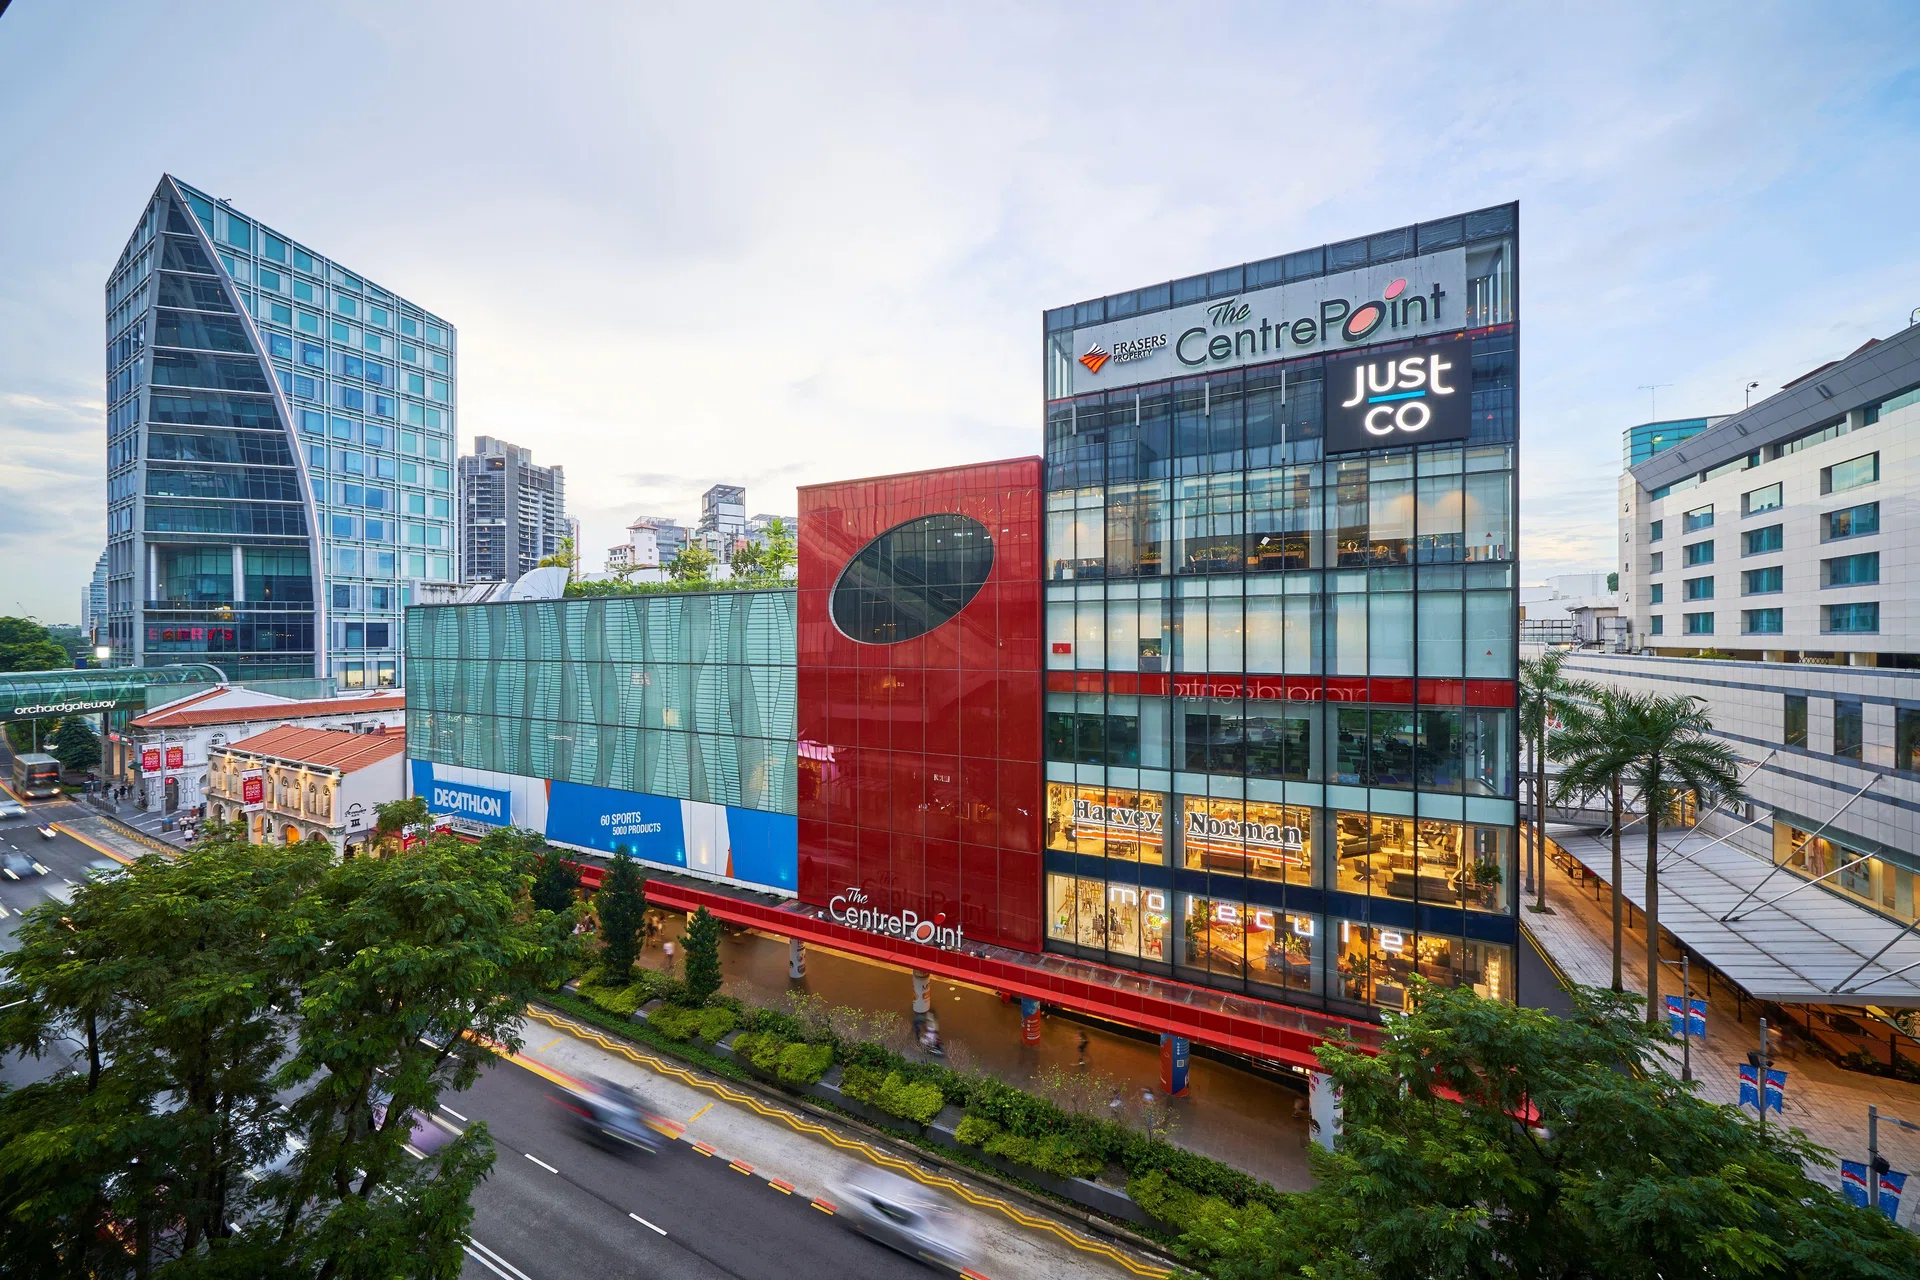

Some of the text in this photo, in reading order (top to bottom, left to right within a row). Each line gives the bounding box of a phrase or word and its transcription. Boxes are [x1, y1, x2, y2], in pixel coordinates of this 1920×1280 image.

[1175, 278, 1446, 366] CentrePoint
[1207, 298, 1250, 327] The
[1113, 334, 1167, 354] FRASERS
[1113, 348, 1153, 363] PROPERTY
[14, 700, 116, 715] orchardgateway
[434, 787, 501, 818] DECATHLON
[600, 811, 642, 826] 60 SPORTS
[1073, 800, 1303, 845] Harvey Norman
[612, 822, 662, 836] 5000 PRODUCTS
[845, 887, 869, 904] The
[829, 895, 964, 948] CentrePoint
